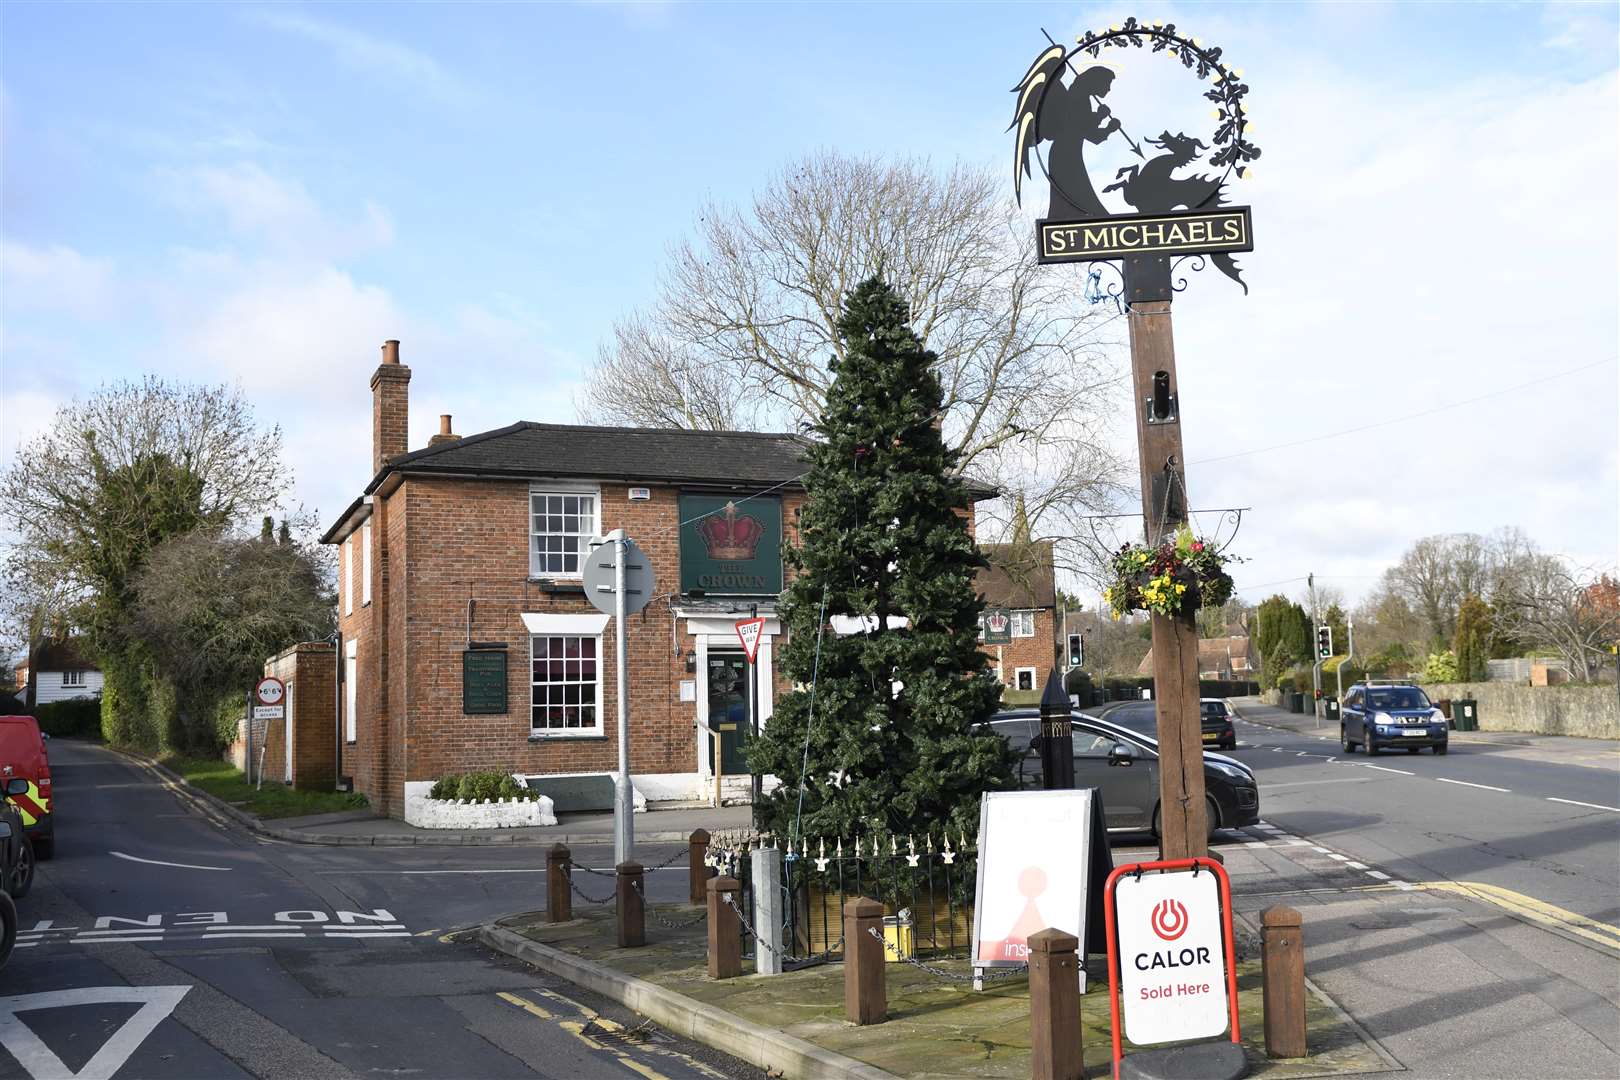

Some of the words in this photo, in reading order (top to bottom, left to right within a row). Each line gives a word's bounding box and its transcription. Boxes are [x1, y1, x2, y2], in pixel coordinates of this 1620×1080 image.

[1083, 219, 1240, 249] MICHAELS
[698, 575, 766, 588] CROWN
[741, 624, 758, 635] GIVE
[274, 909, 398, 924] NO
[1135, 947, 1211, 971] CALOR
[1140, 984, 1173, 1000] Sold
[1177, 983, 1210, 996] Here
